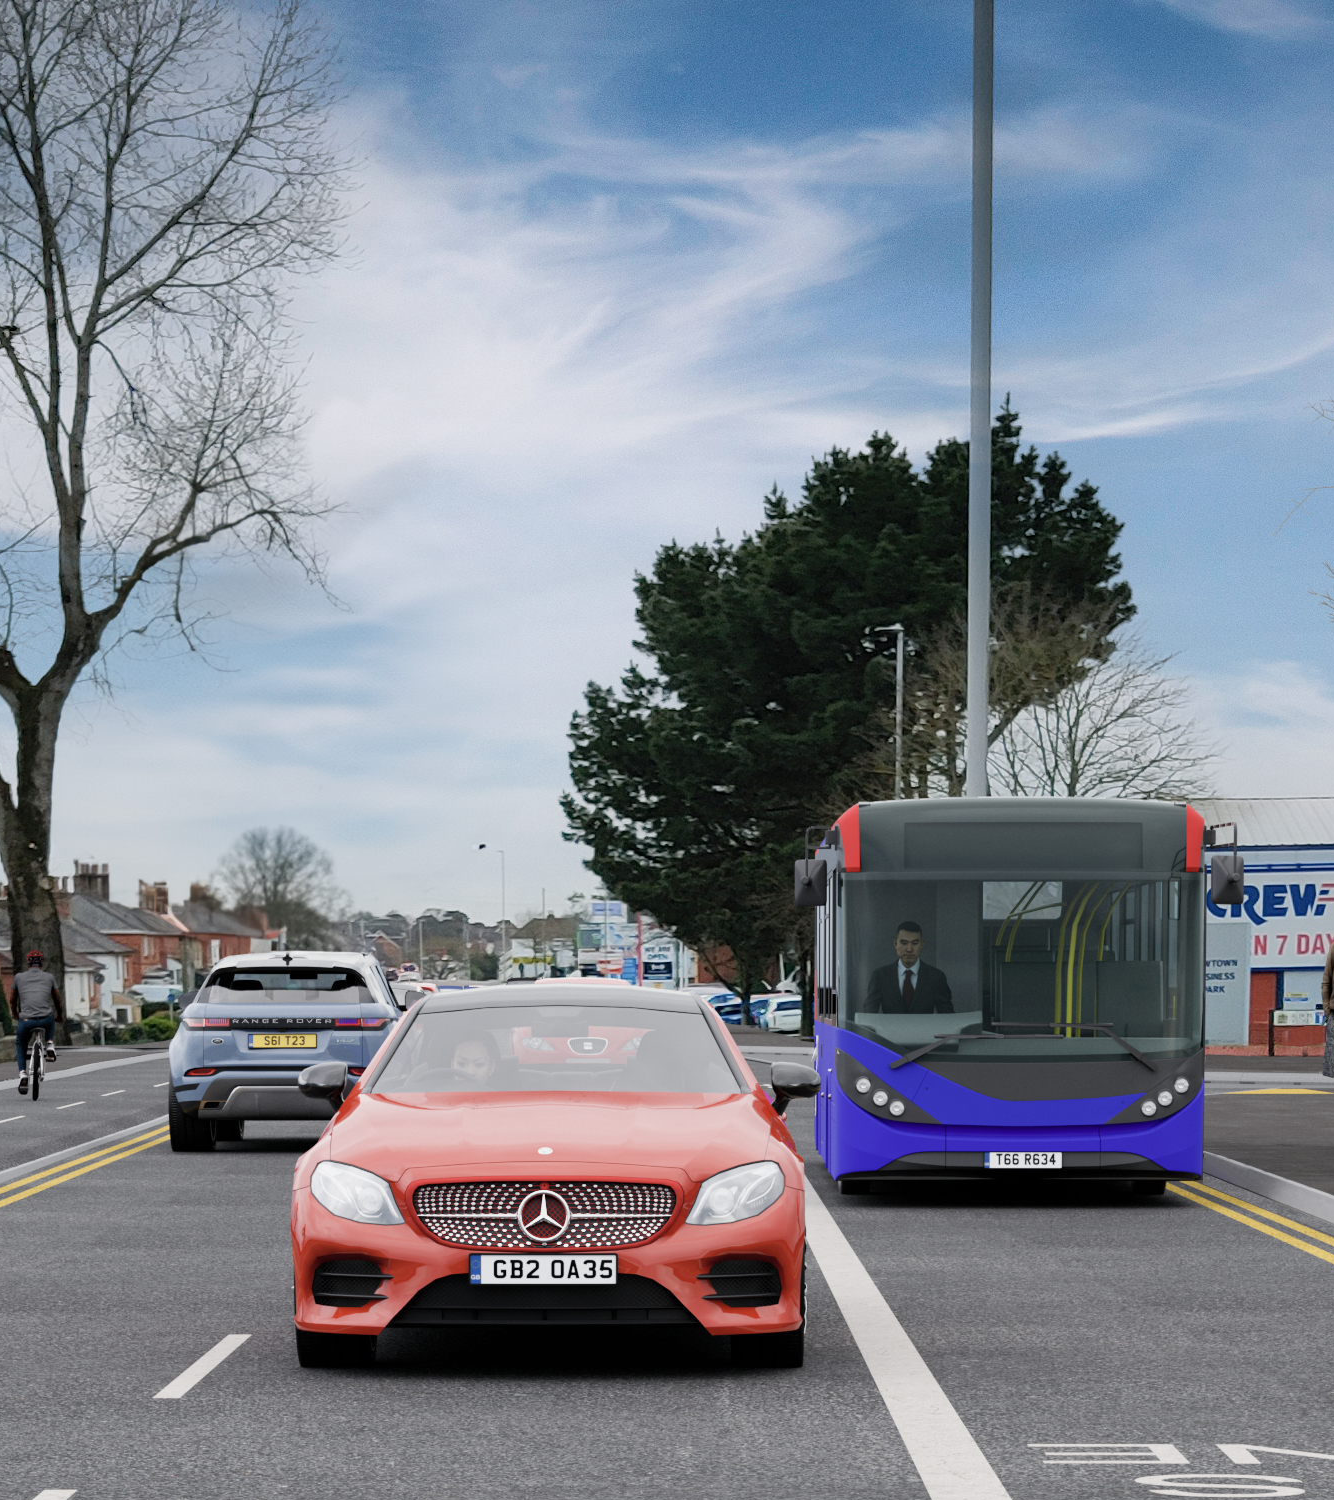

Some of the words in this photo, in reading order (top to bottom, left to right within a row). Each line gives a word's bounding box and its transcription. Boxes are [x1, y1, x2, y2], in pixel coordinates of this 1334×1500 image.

[1276, 935, 1288, 956] 7
[284, 1036, 306, 1046] T23
[996, 1153, 1020, 1165] T66
[1024, 1153, 1056, 1165] R634
[493, 1259, 540, 1279] GB2
